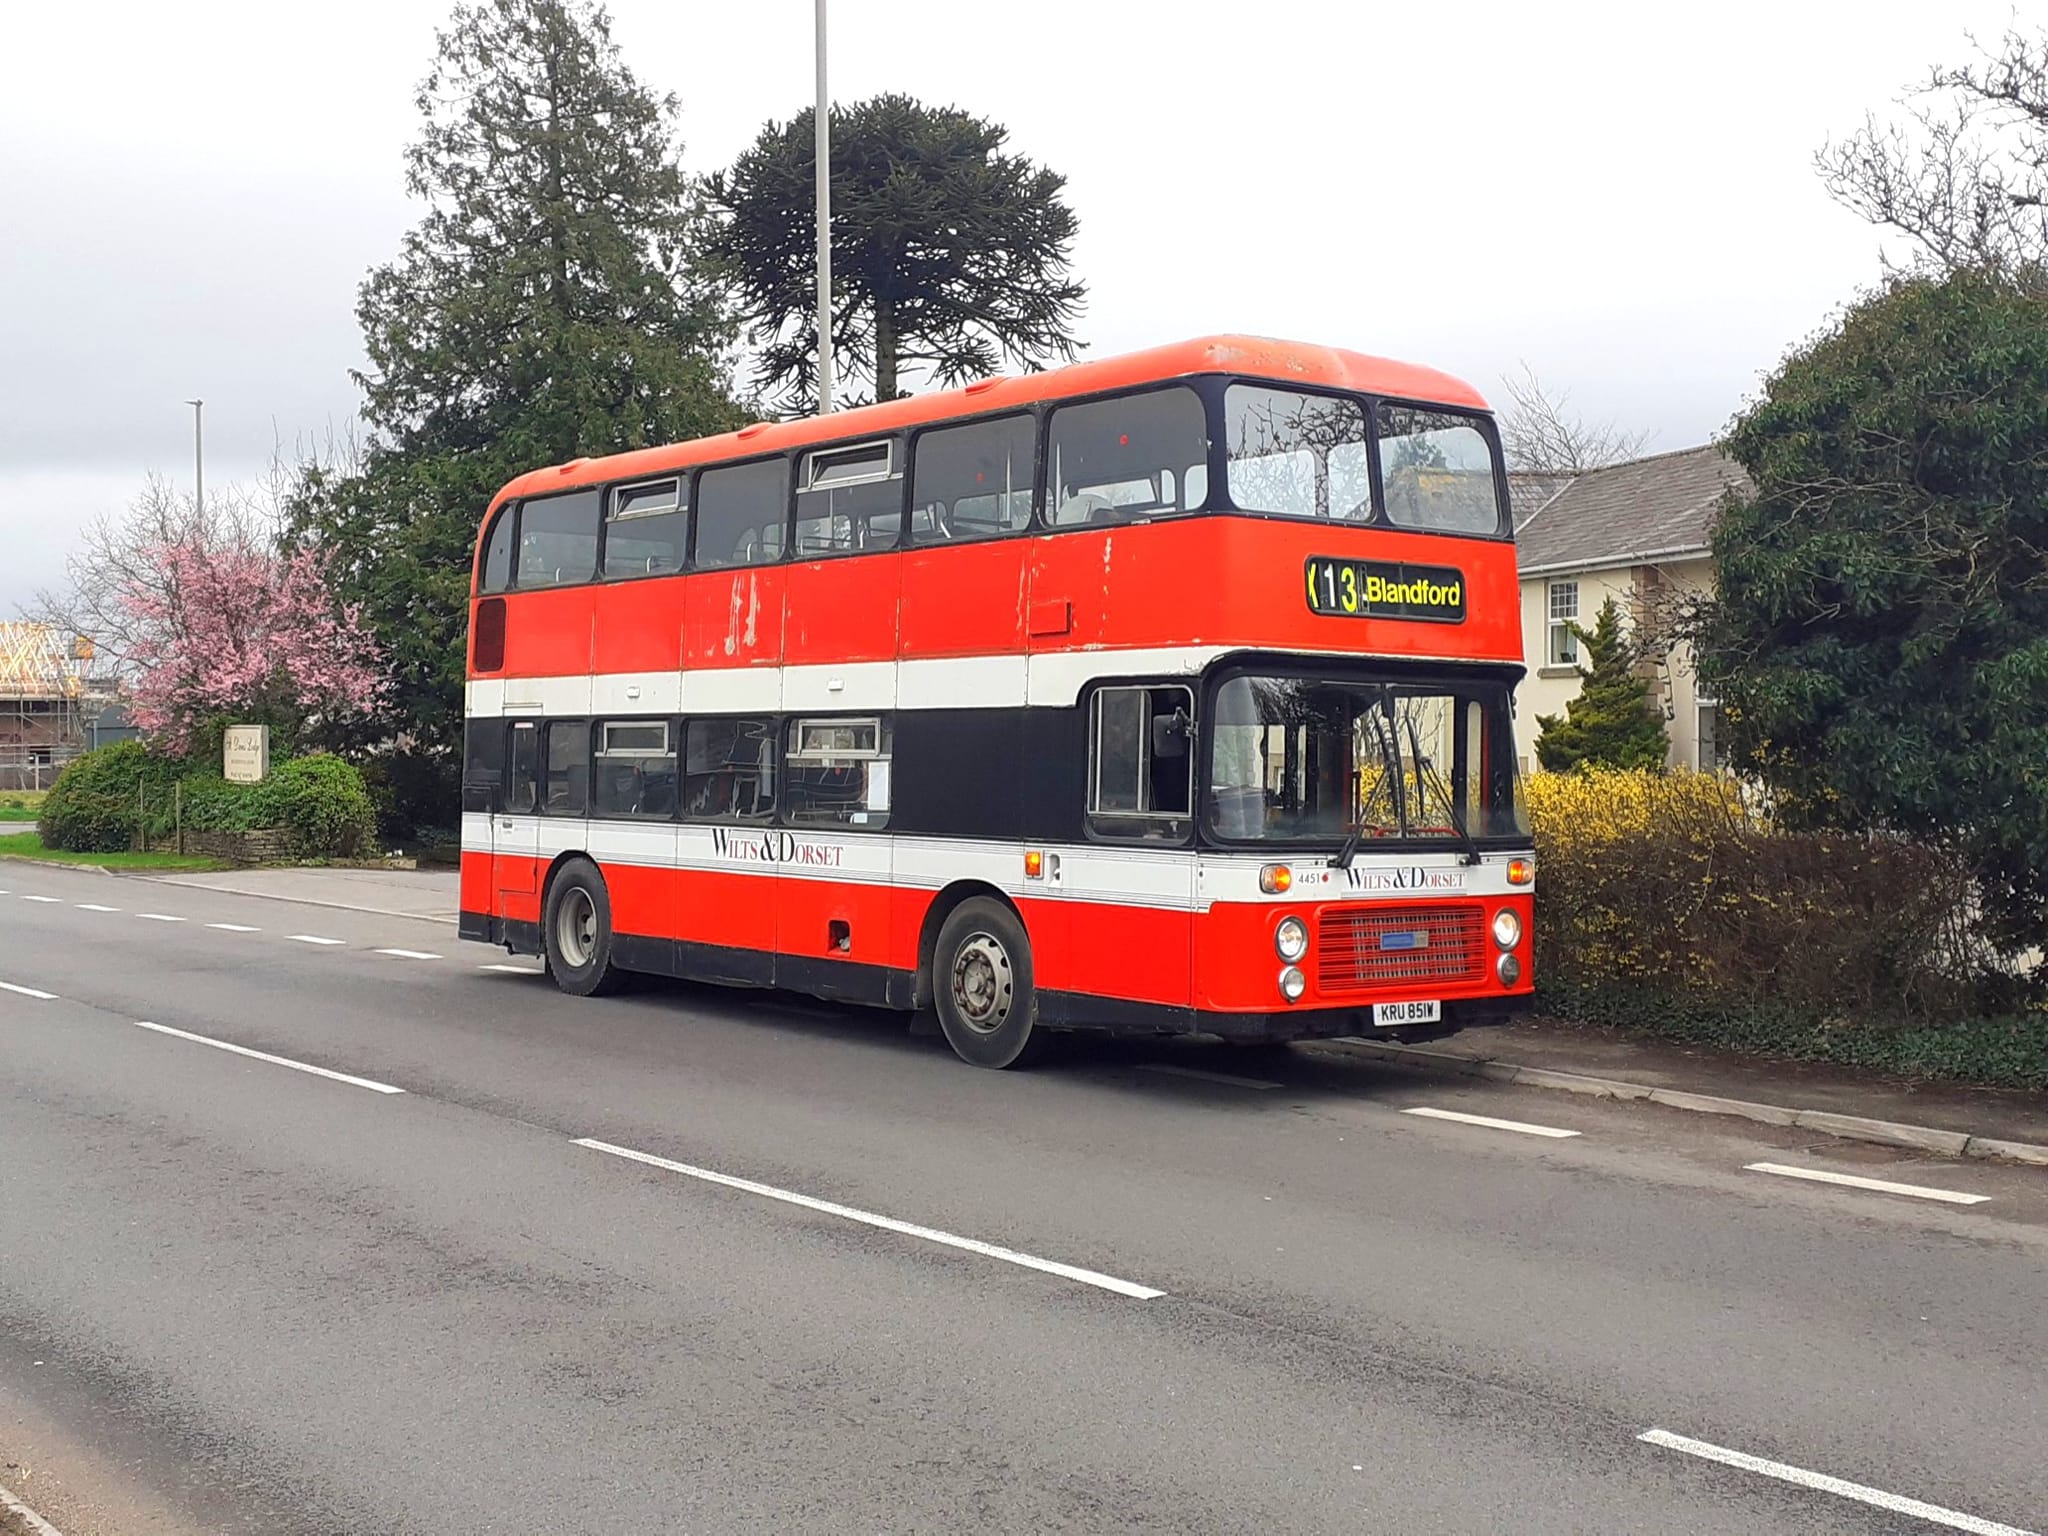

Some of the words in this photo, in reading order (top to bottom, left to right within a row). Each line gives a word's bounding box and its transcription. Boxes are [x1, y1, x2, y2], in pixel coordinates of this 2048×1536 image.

[1367, 576, 1460, 606] Blandford
[712, 828, 758, 861] WILTS
[760, 831, 778, 861] &
[779, 832, 843, 866] DORSET
[1298, 873, 1319, 884] 4451
[1346, 867, 1391, 889] WILTS
[1411, 867, 1465, 888] DORSET
[1381, 1005, 1405, 1021] KRU
[1408, 1002, 1434, 1019] 851W
